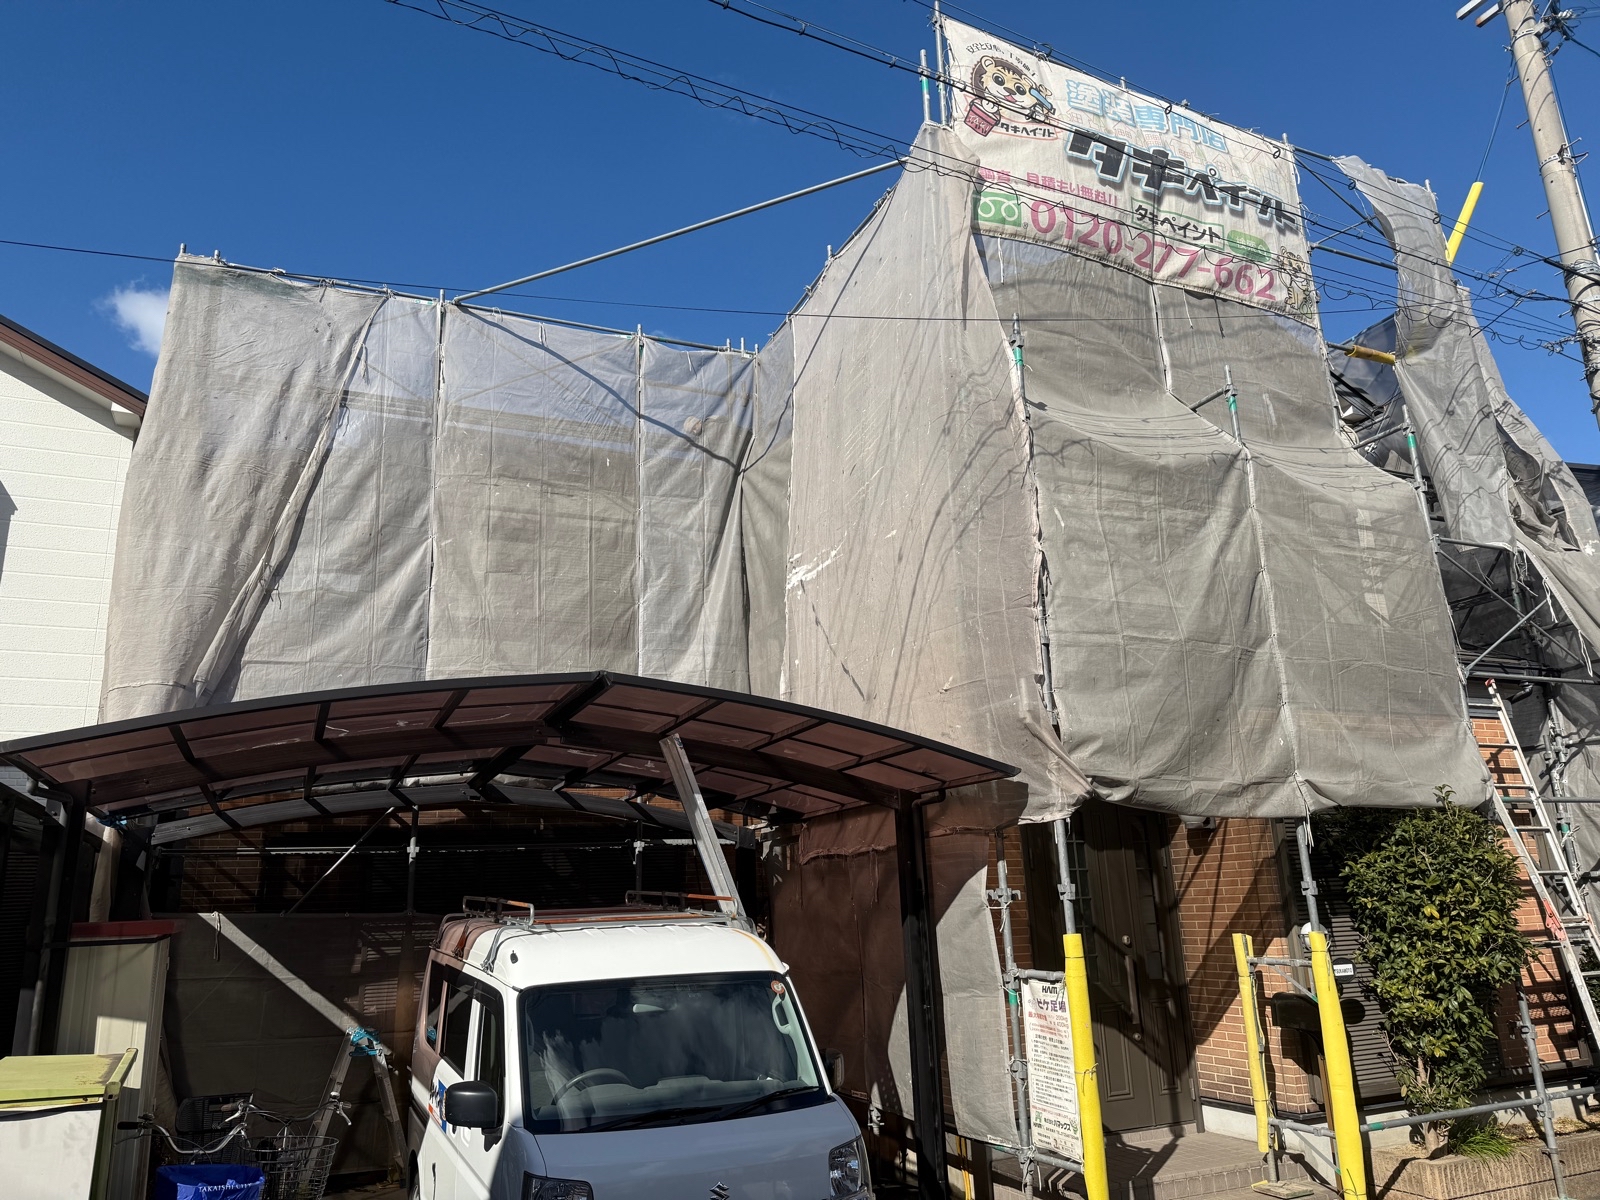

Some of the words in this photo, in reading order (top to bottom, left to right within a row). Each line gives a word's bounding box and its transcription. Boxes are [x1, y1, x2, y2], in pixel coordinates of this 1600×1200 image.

[1066, 79, 1228, 153] 塗装専門店
[1068, 128, 1297, 226] タキペイント
[1031, 200, 1276, 301] 0120-277-662
[1135, 204, 1222, 244] タキペイント
[199, 1183, 234, 1193] TAKAISHI
